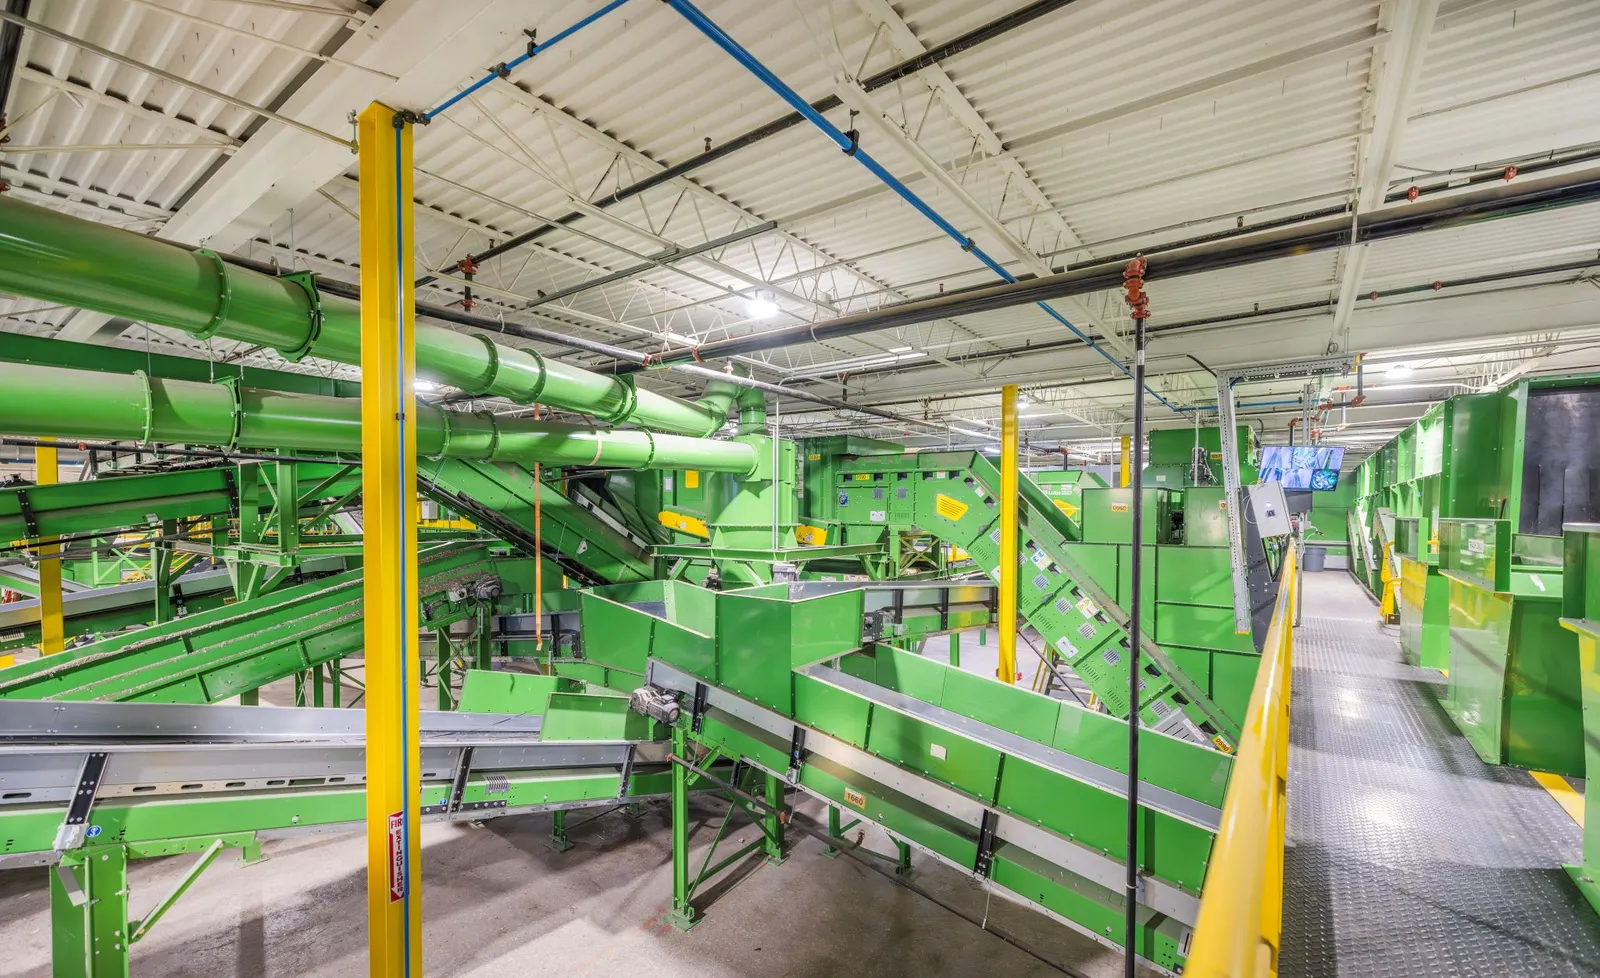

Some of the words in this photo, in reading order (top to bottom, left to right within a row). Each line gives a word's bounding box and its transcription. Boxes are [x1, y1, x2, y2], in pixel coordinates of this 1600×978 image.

[847, 792, 863, 806] 1660
[391, 818, 403, 830] FIR
[395, 828, 404, 893] EXTINGUISHER
